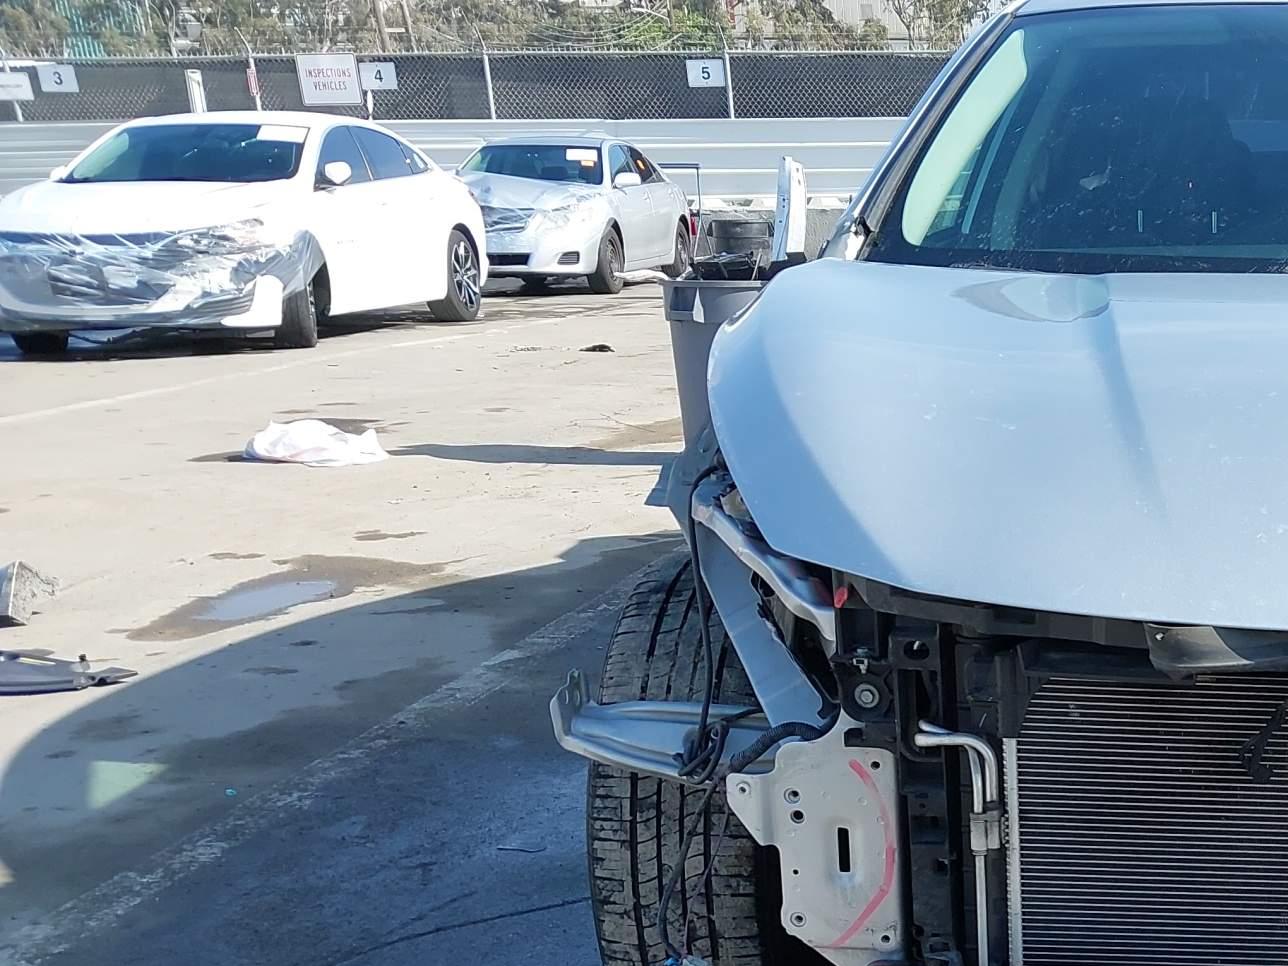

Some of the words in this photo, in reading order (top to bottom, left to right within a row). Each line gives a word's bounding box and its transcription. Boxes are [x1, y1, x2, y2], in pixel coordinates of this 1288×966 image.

[53, 71, 63, 86] 3
[305, 67, 351, 78] INSPECTIONS
[374, 69, 384, 83] 4
[701, 66, 711, 80] 5
[313, 80, 348, 91] VEHICLES
